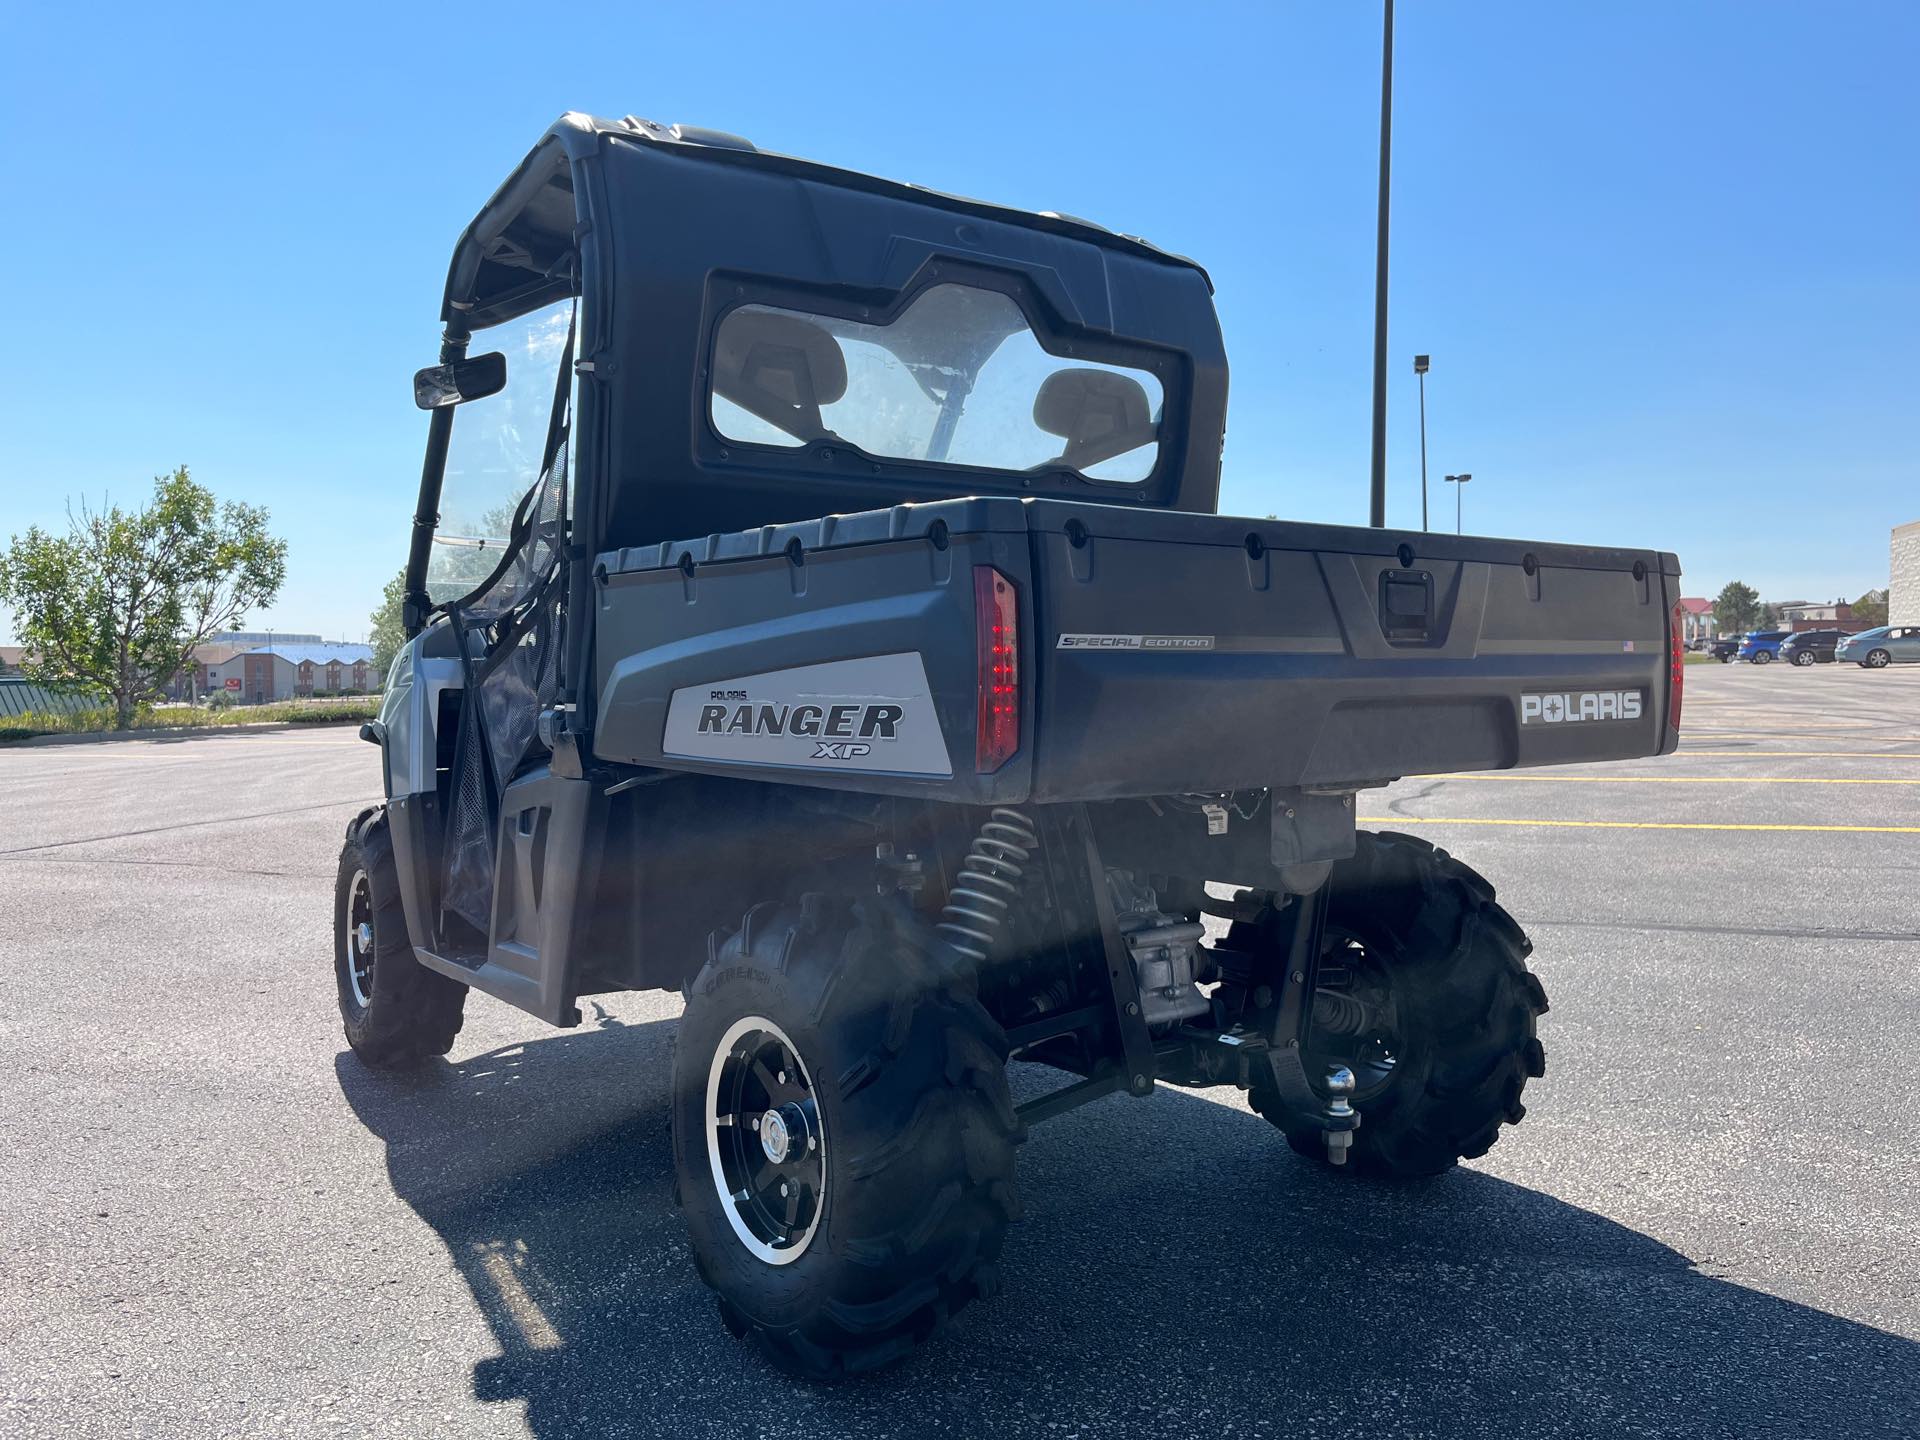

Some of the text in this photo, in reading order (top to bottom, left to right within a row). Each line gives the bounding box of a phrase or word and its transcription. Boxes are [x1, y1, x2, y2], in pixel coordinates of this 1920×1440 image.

[1062, 636, 1209, 647] SPECIAL EDITION
[710, 690, 747, 700] POLARIS
[1521, 692, 1641, 724] POLARIS
[697, 704, 904, 740] RANGER
[810, 742, 871, 760] XP
